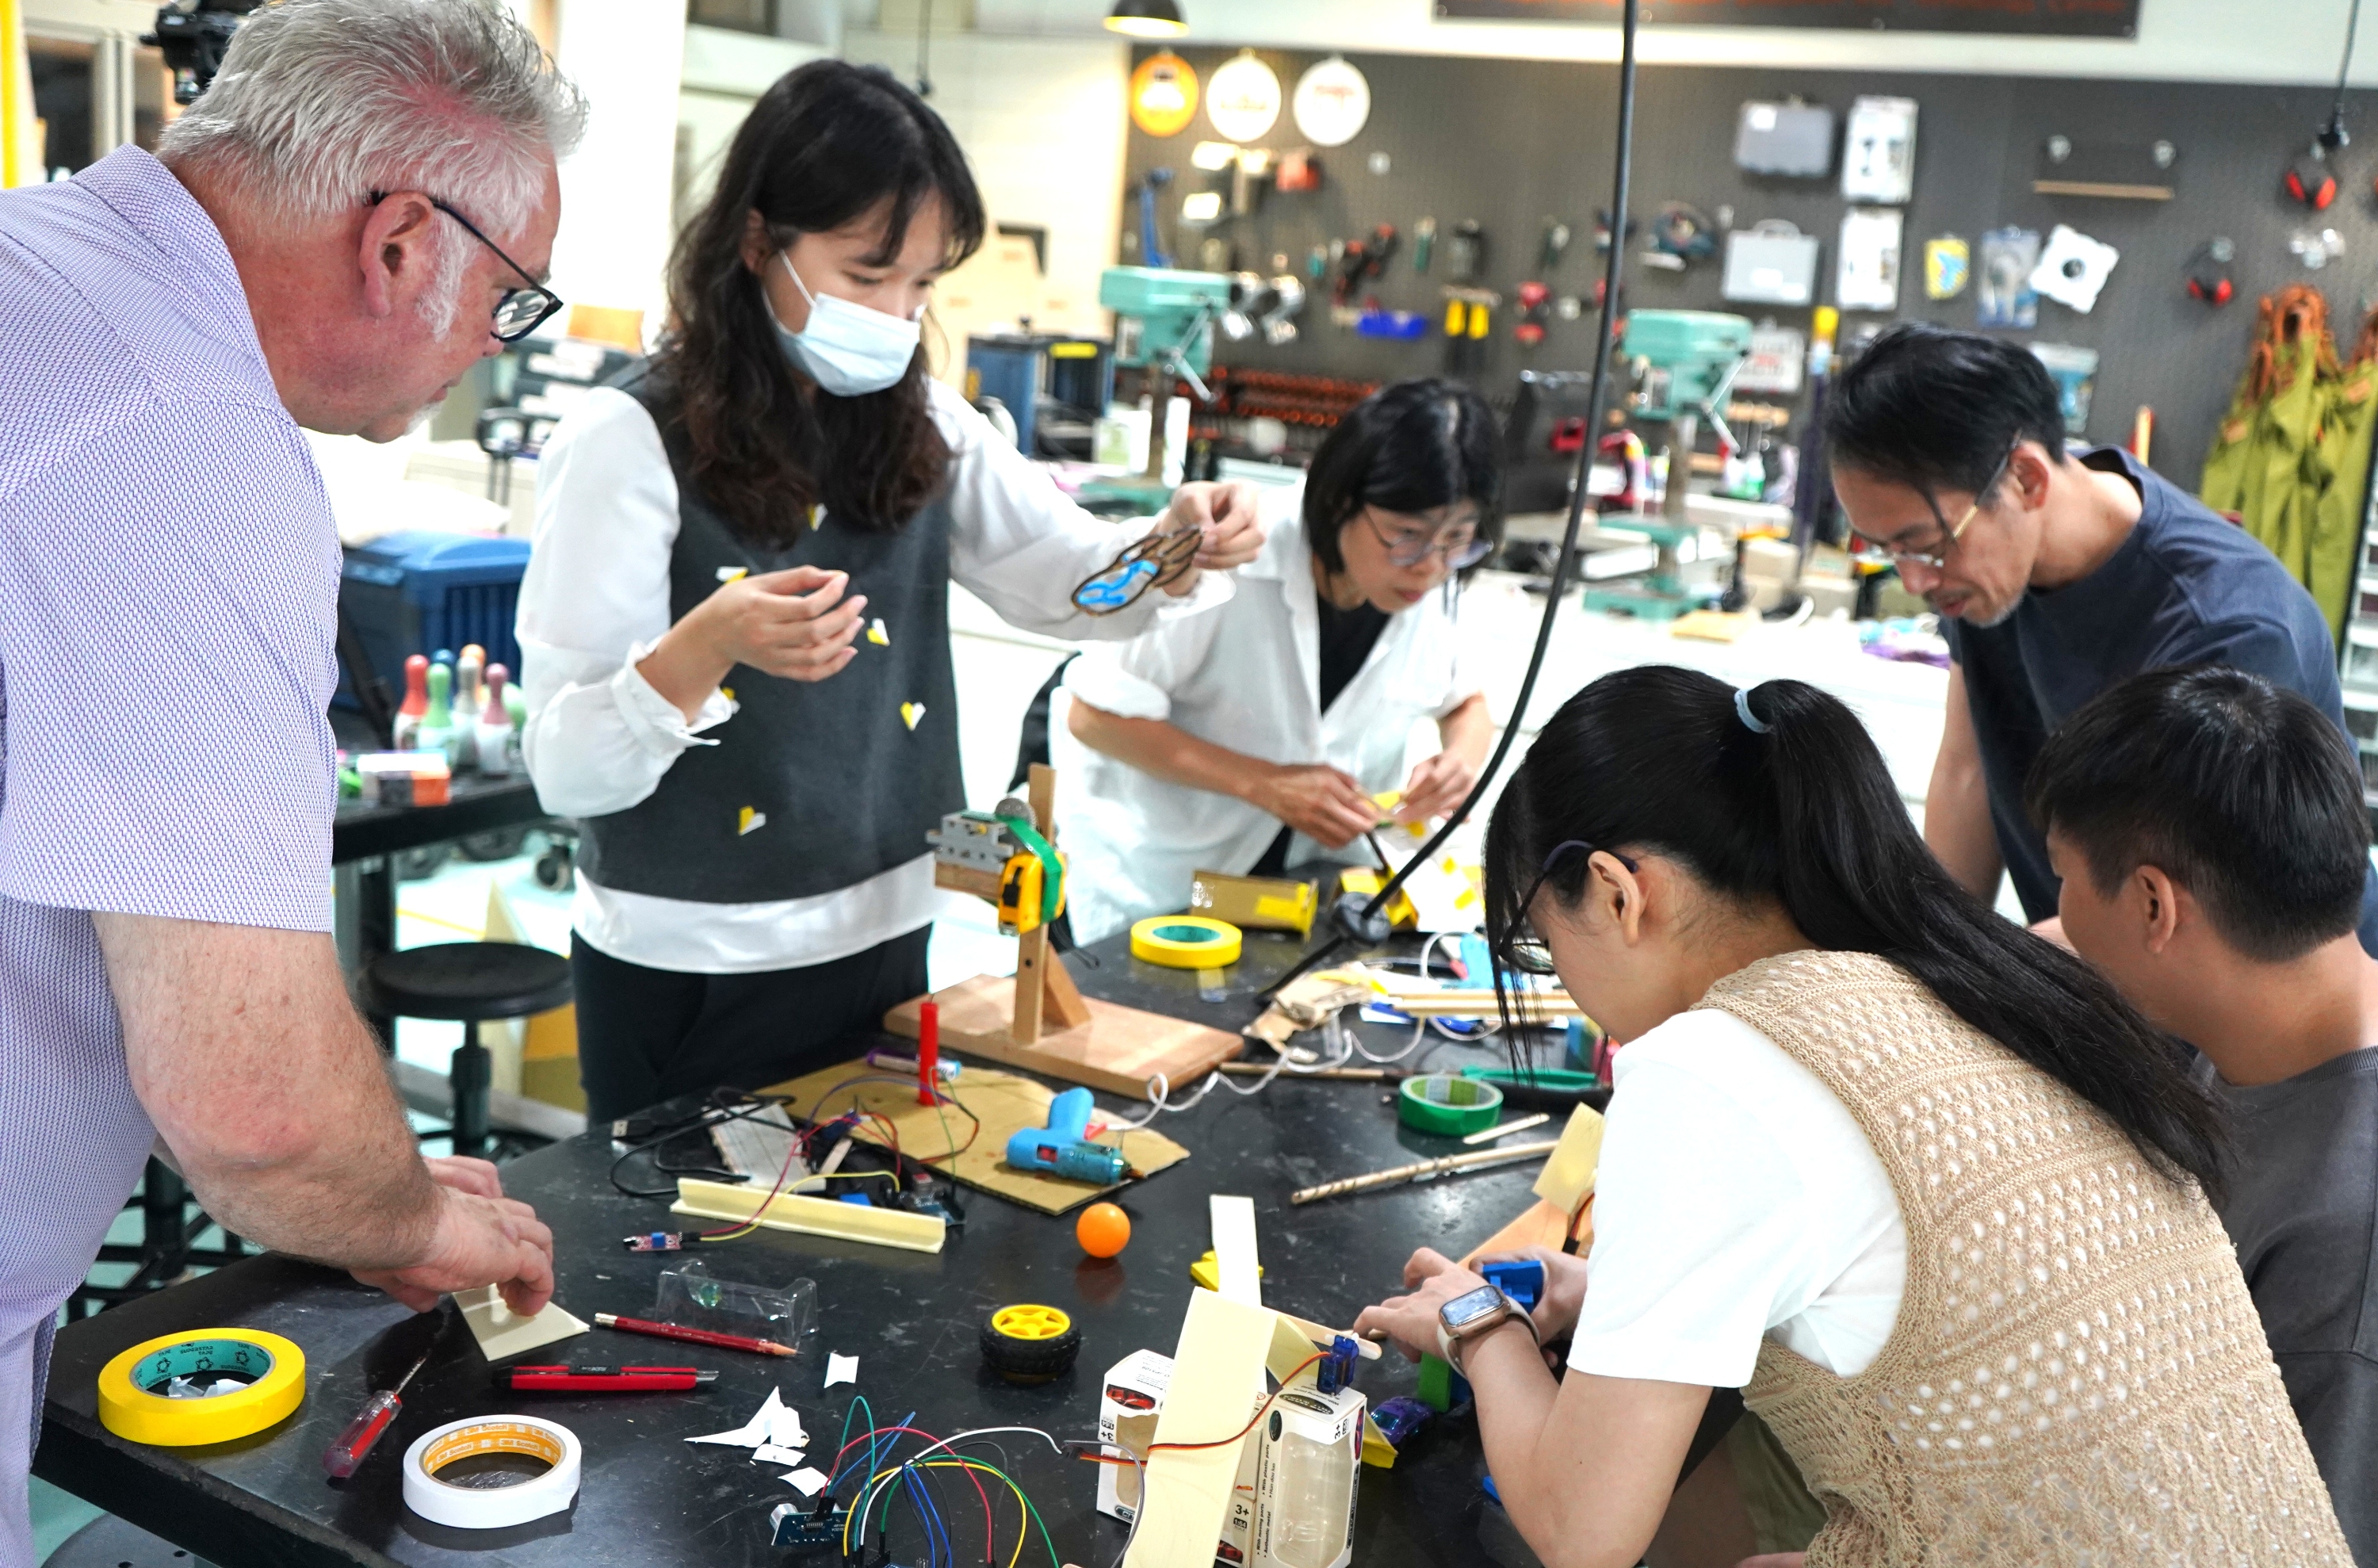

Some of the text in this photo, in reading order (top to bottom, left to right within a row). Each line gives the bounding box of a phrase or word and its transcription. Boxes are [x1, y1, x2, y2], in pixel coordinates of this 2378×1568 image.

[1101, 1430, 1114, 1441] 3+
[1335, 1424, 1341, 1440] 3+
[449, 1443, 472, 1455] Scotch
[517, 1440, 538, 1451] Scotch
[1235, 1505, 1249, 1516] 3+
